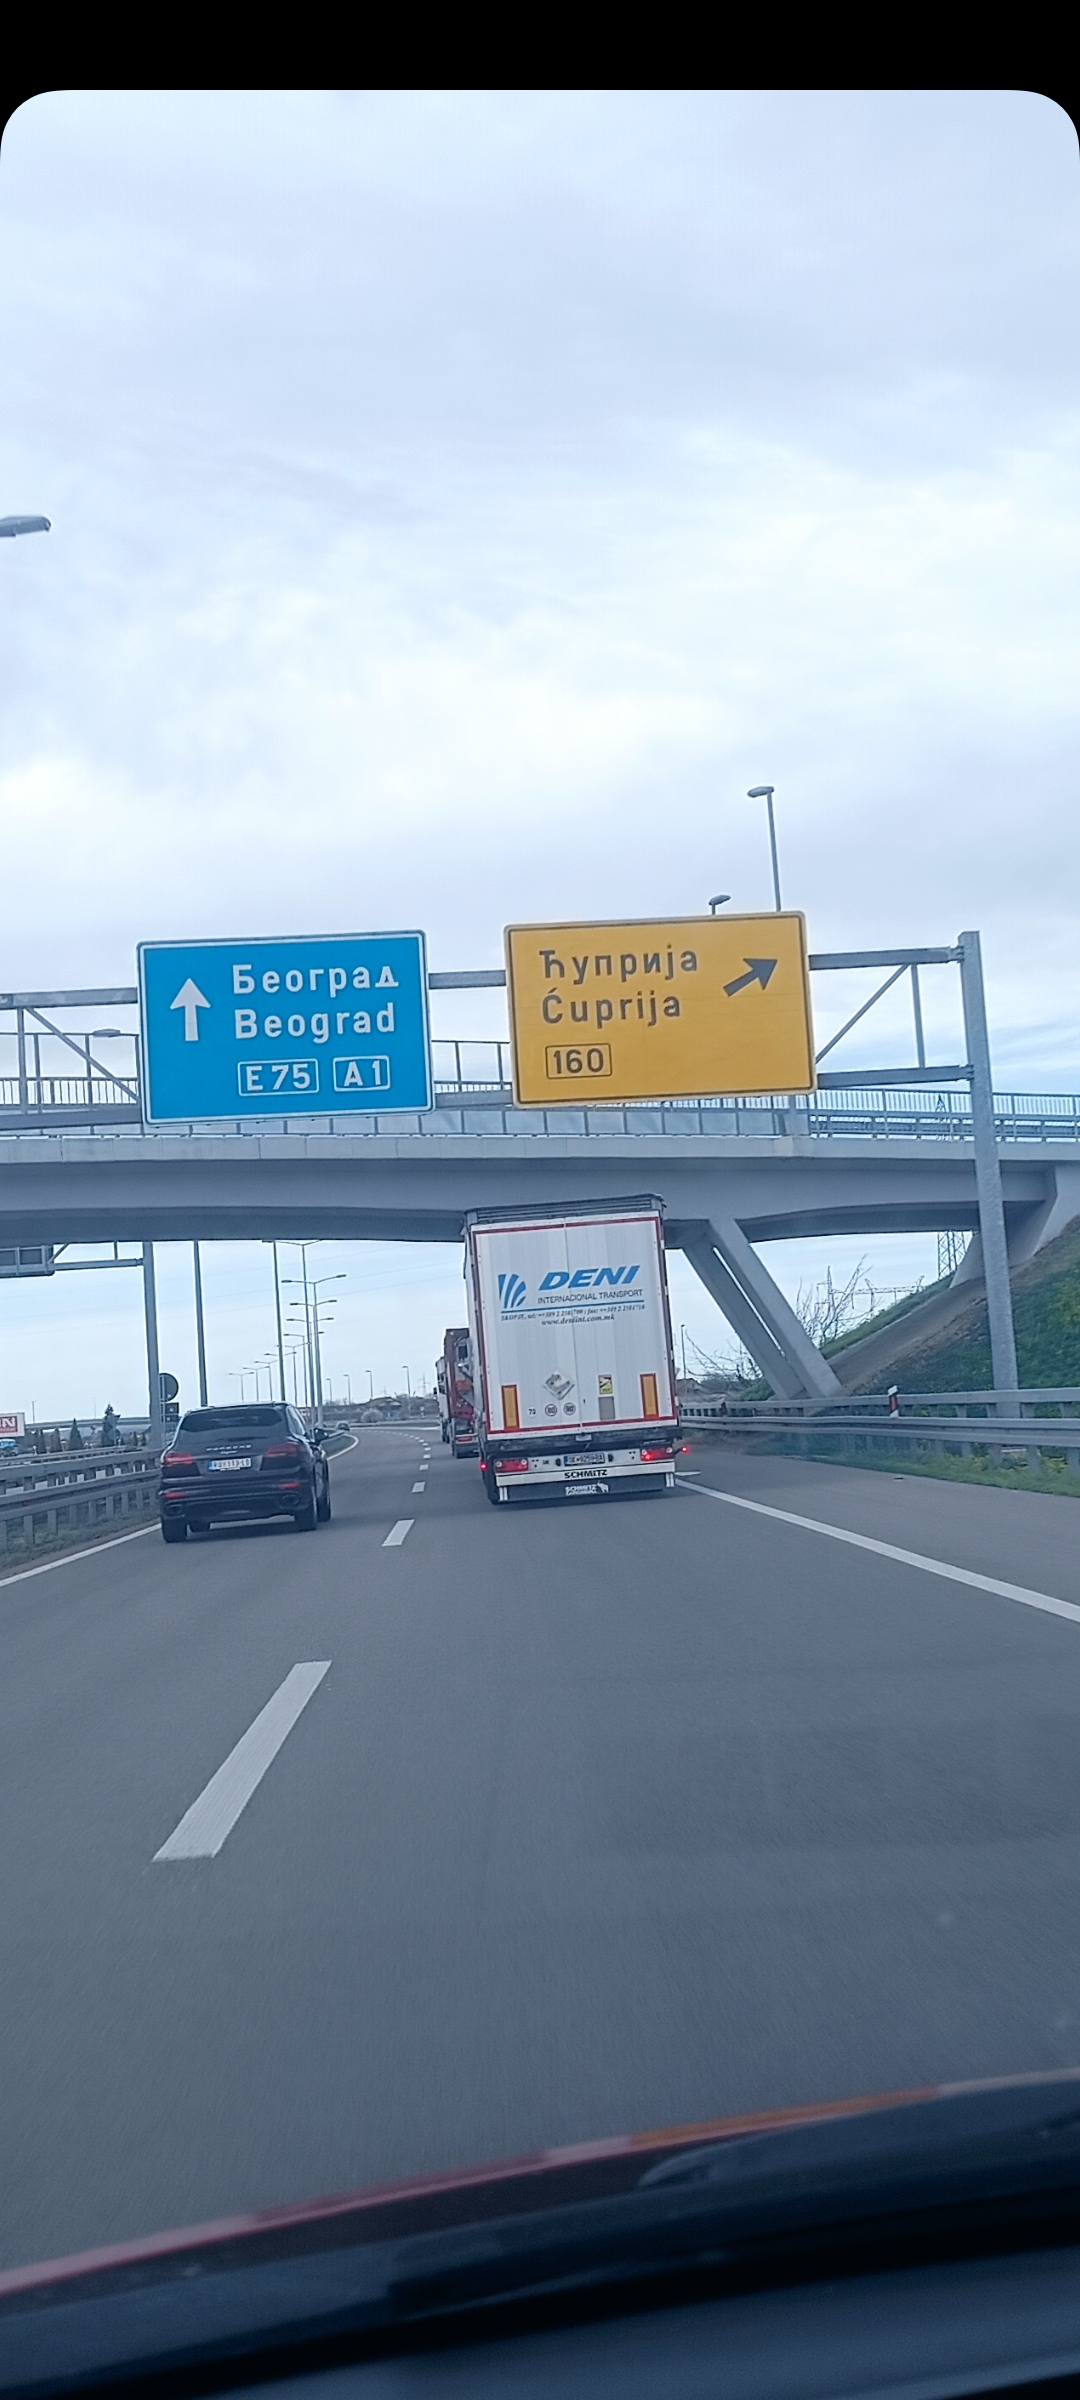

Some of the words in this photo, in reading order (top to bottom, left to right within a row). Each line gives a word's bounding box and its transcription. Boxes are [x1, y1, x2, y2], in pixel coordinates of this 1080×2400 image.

[539, 944, 698, 985] Ћуприја
[232, 964, 399, 998] Београд
[234, 1002, 395, 1044] Beograd
[542, 987, 681, 1029] Ćuprija
[552, 1048, 604, 1074] 160
[538, 1265, 640, 1291] DENI
[599, 1289, 643, 1301] TRANSPORT
[564, 1469, 608, 1479] SCHMITZ
